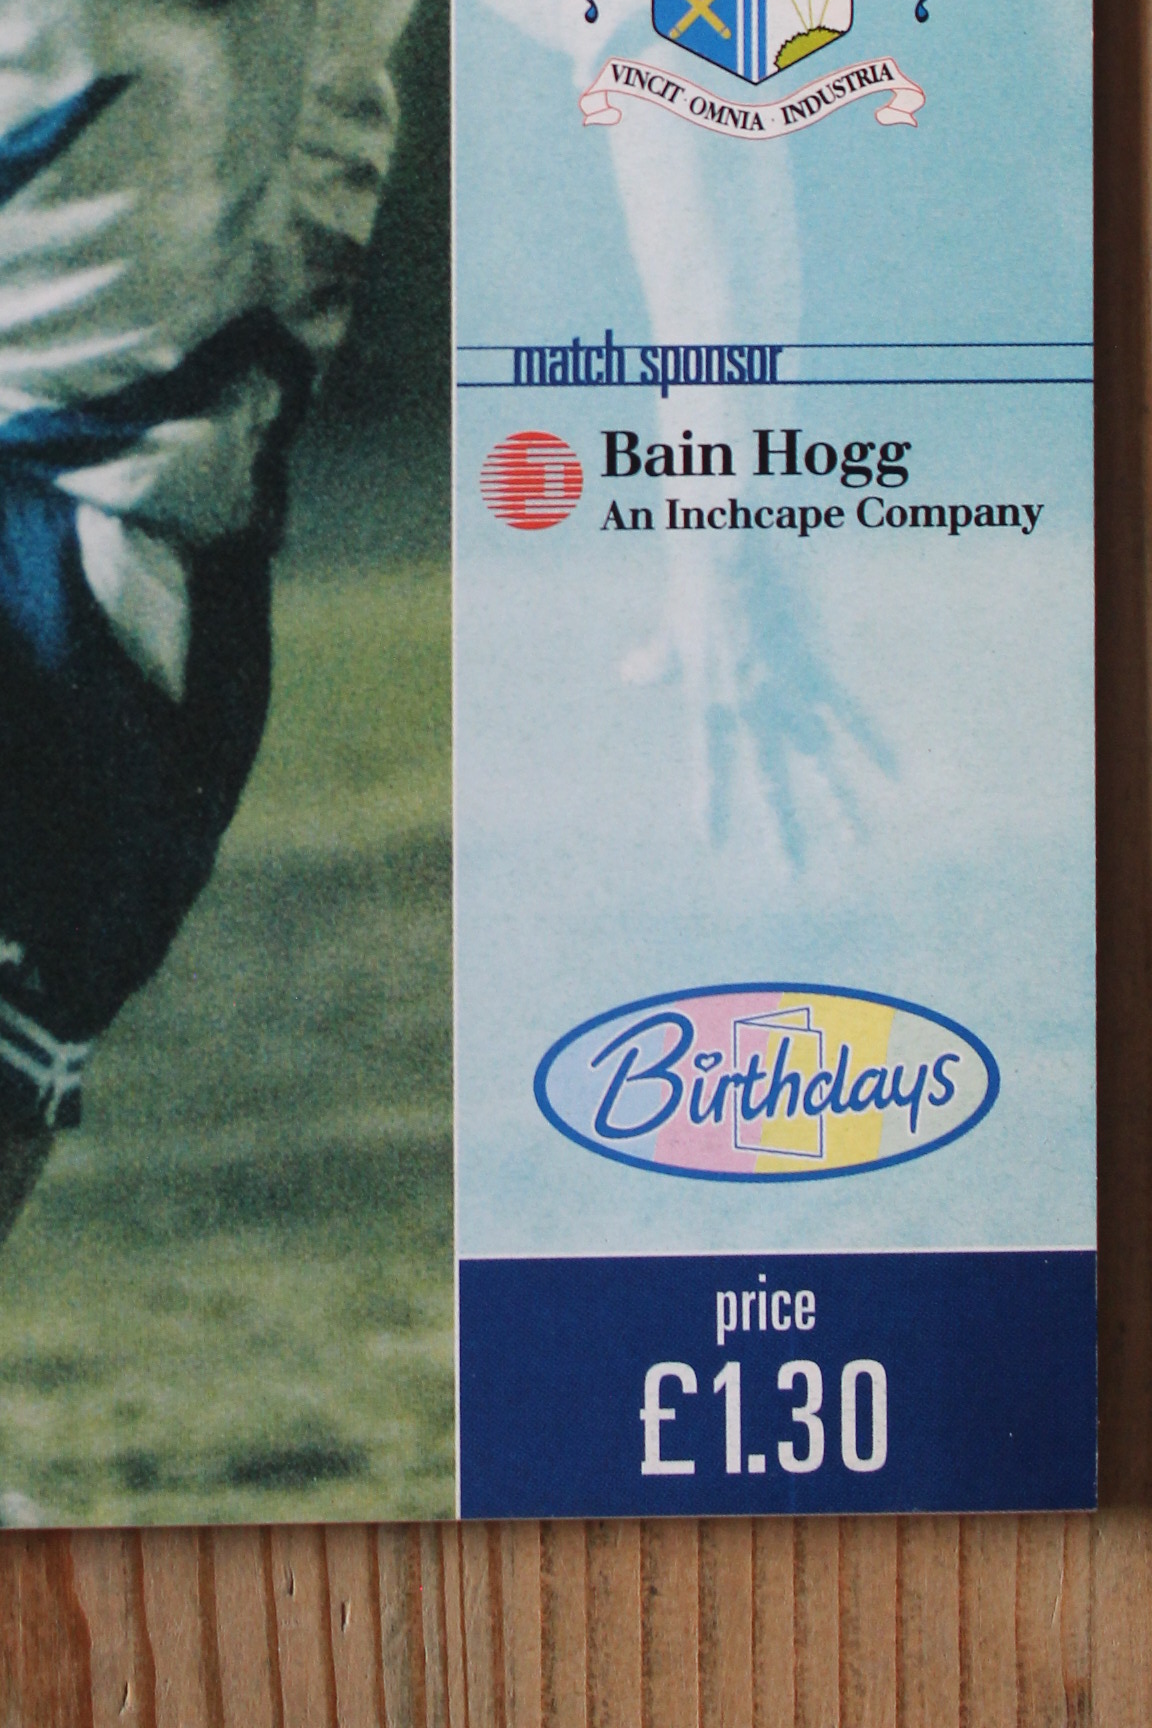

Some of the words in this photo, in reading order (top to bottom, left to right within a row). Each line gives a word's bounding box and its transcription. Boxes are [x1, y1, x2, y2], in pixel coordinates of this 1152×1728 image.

[610, 63, 686, 104] VINCIT
[688, 96, 766, 132] OMNIA
[781, 63, 896, 125] INDUSTRIA
[512, 328, 627, 385] match
[639, 344, 784, 399] sponsor
[600, 430, 736, 477] Bain
[752, 428, 912, 489] Hogg
[600, 500, 655, 530] An
[665, 498, 846, 537] Inchcape
[855, 496, 1046, 536] Company
[590, 1010, 960, 1140] Birthdays
[716, 1274, 817, 1346] price
[639, 1358, 889, 1475] £1.30
